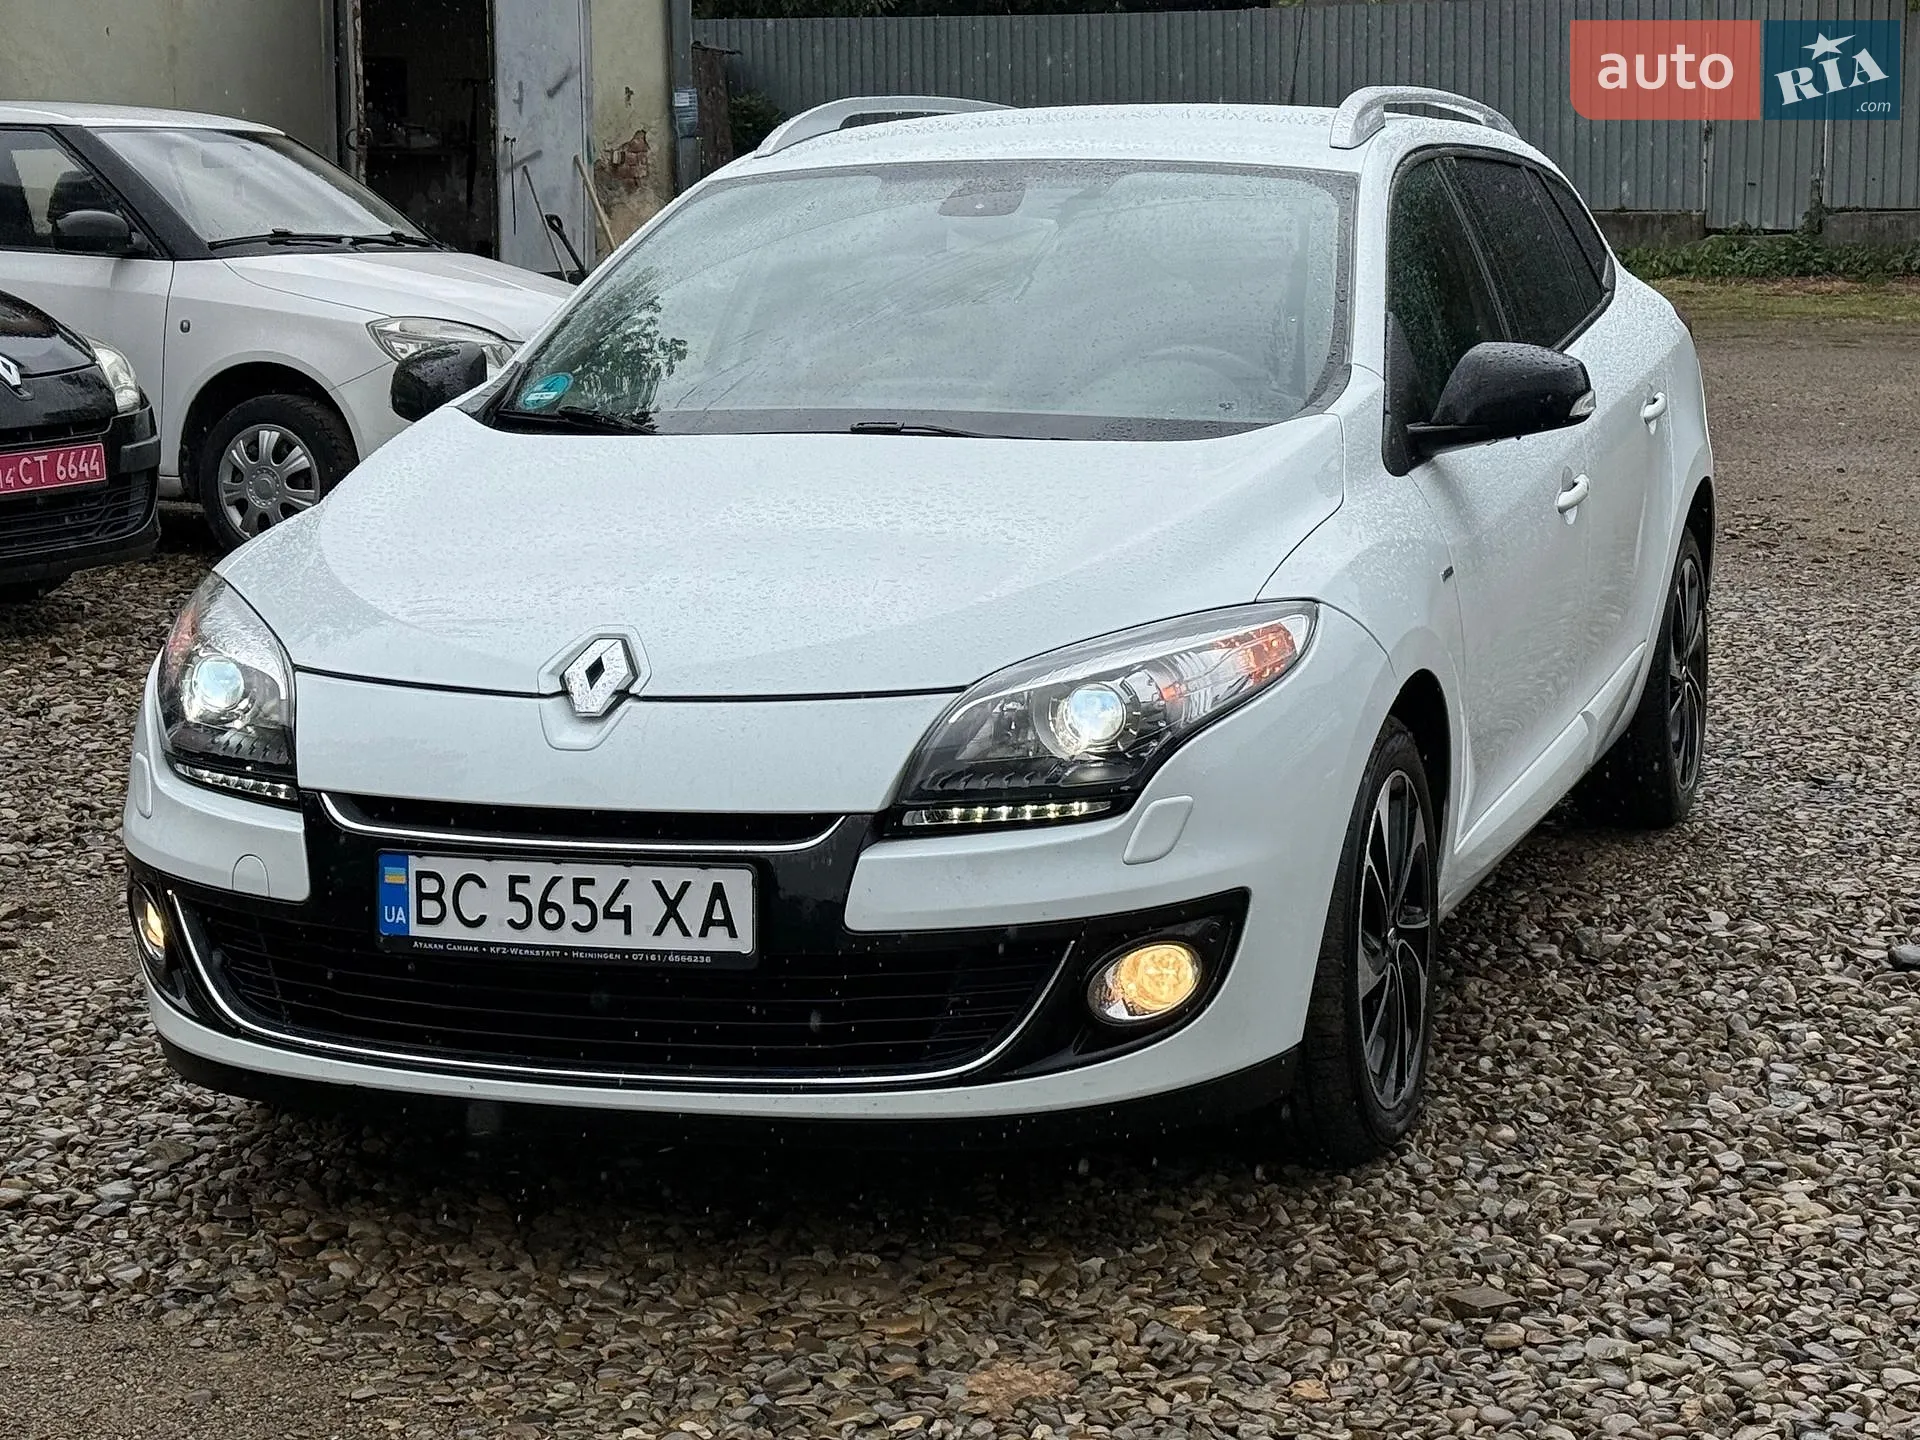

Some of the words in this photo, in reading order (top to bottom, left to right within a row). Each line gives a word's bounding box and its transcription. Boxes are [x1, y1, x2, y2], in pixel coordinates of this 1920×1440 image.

[19, 455, 48, 485] CT
[56, 449, 100, 481] 6644
[384, 906, 406, 924] UA
[414, 870, 487, 928] BC
[506, 874, 632, 935] 5654
[652, 879, 739, 939] XA
